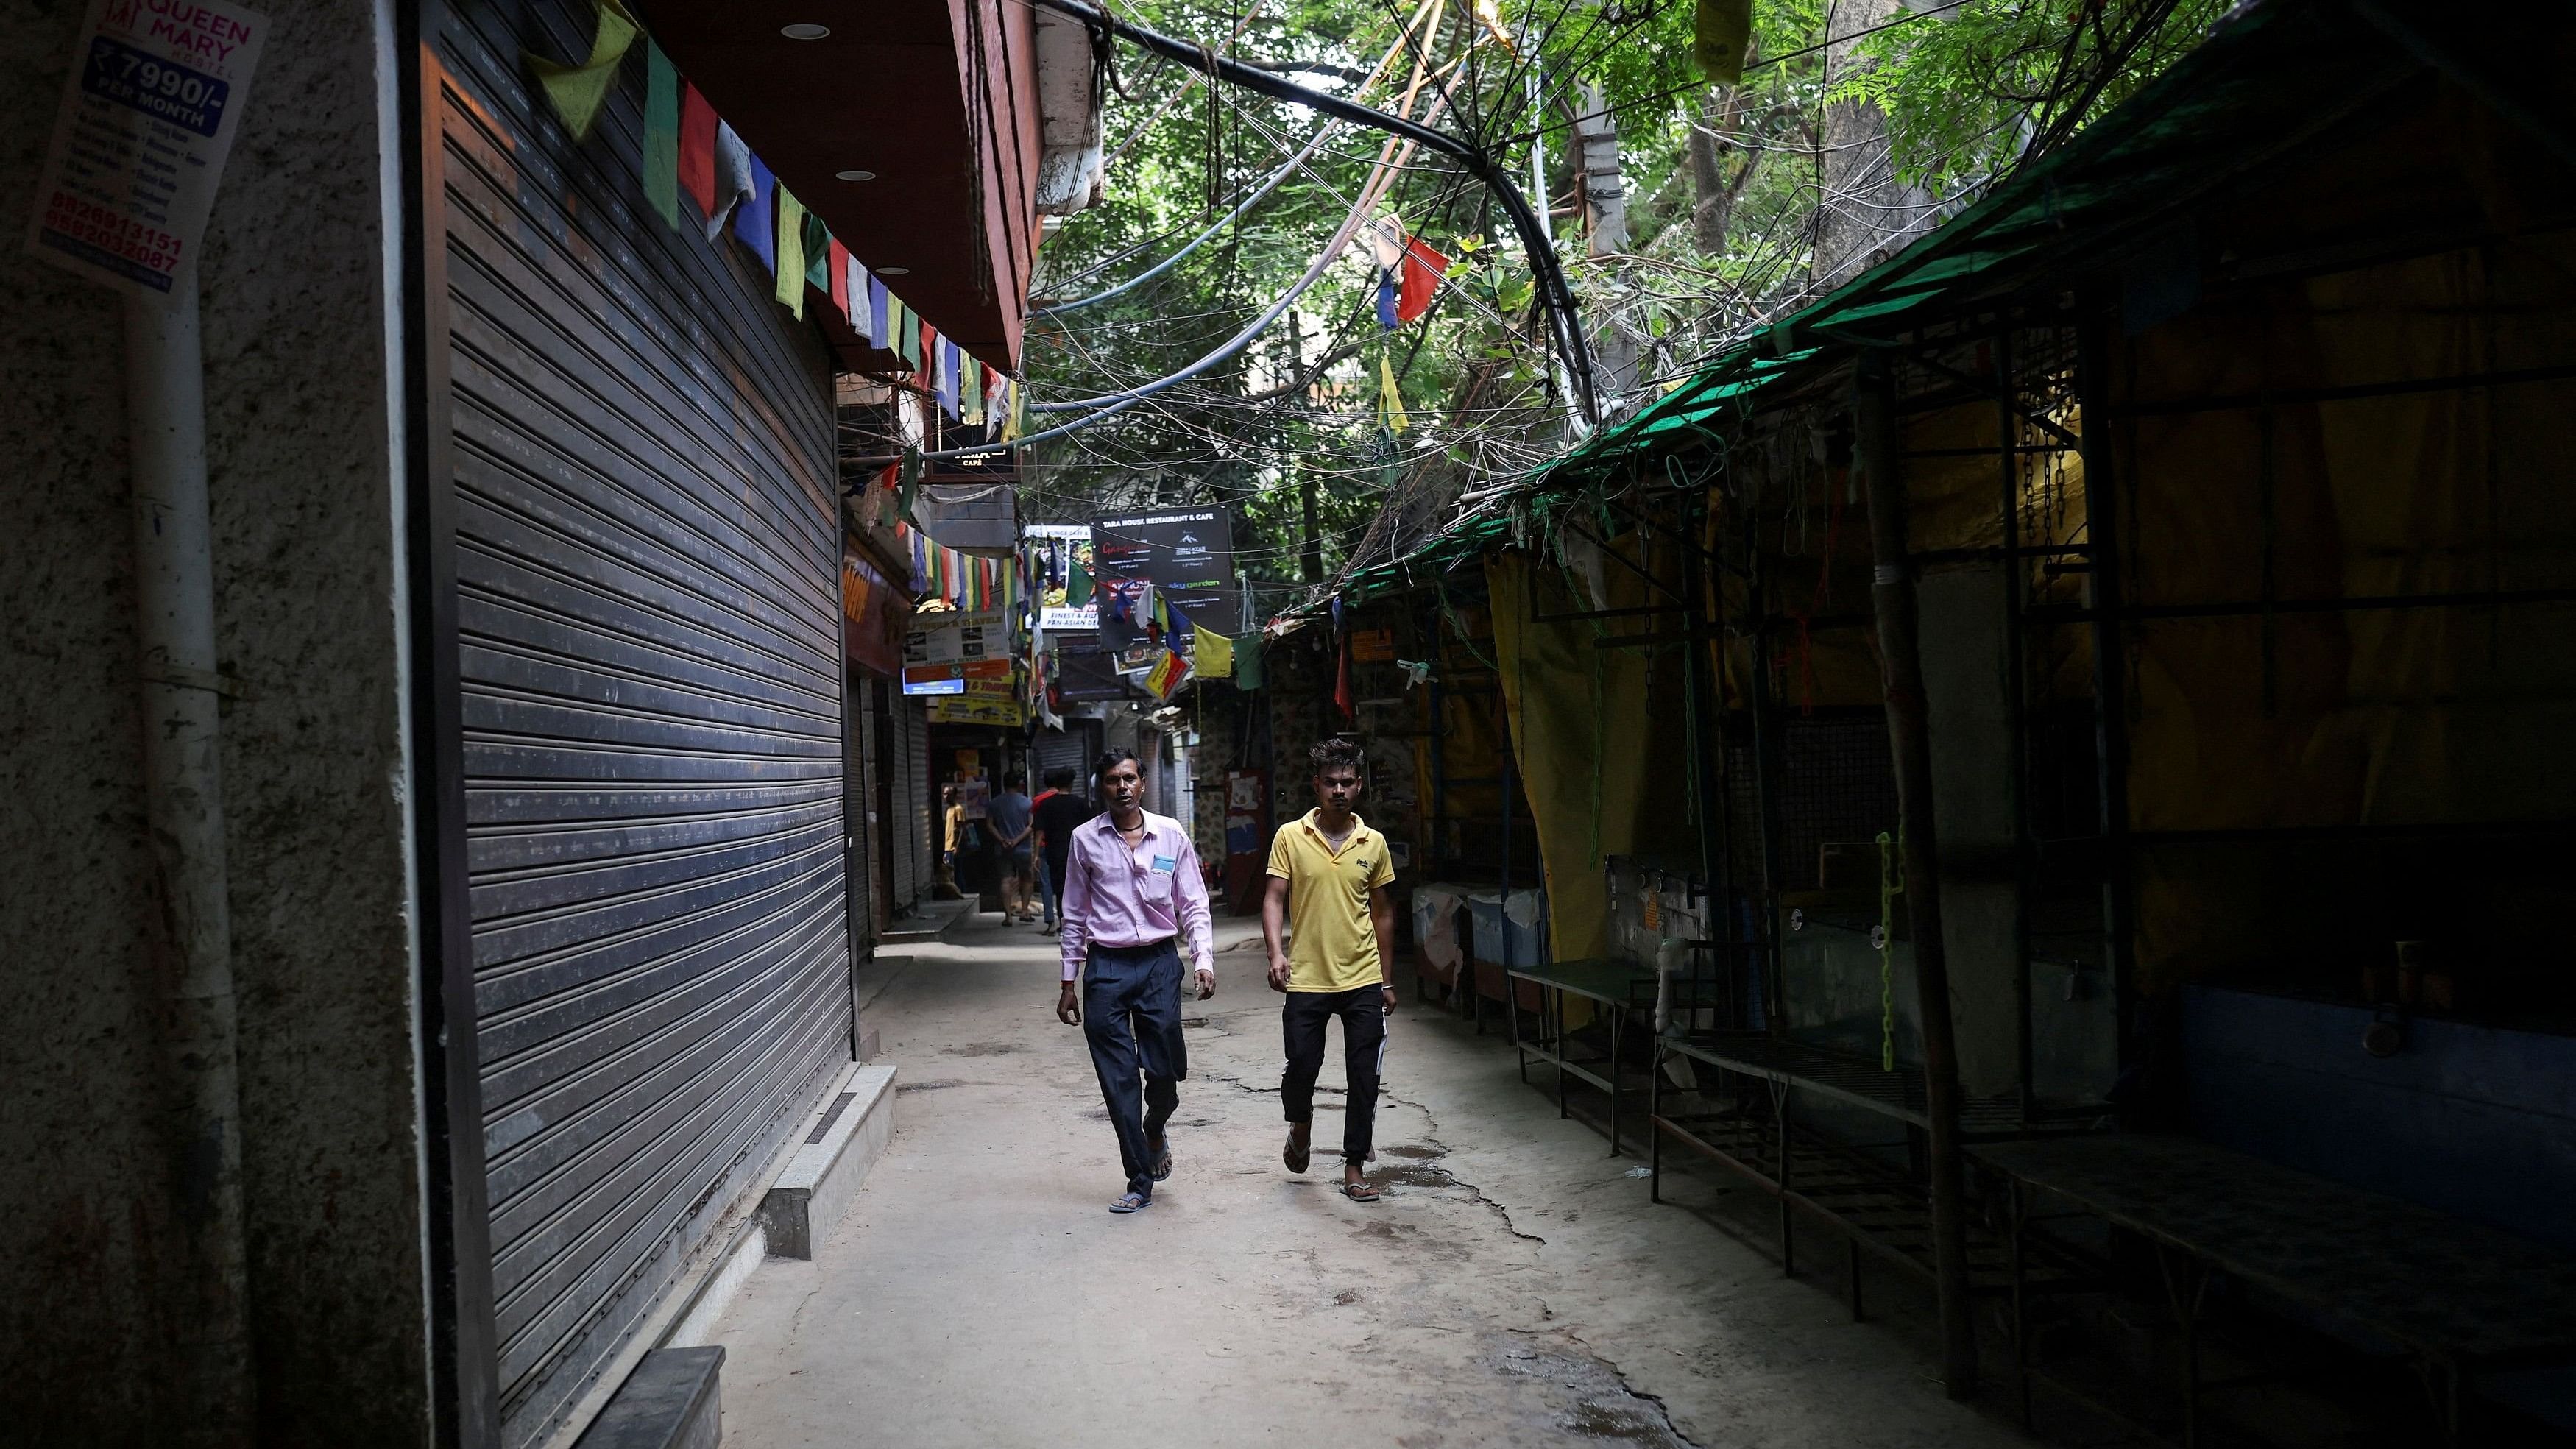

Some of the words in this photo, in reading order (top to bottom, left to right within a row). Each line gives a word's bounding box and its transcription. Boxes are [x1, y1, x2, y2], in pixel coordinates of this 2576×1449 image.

[147, 0, 252, 46] QUEEN
[149, 18, 236, 63] MARY
[171, 49, 238, 80] HOSTEL
[96, 75, 135, 102] PER
[138, 91, 206, 128] MONTH
[1146, 515, 1188, 525] RESTAURANT
[1186, 579, 1220, 589] garden
